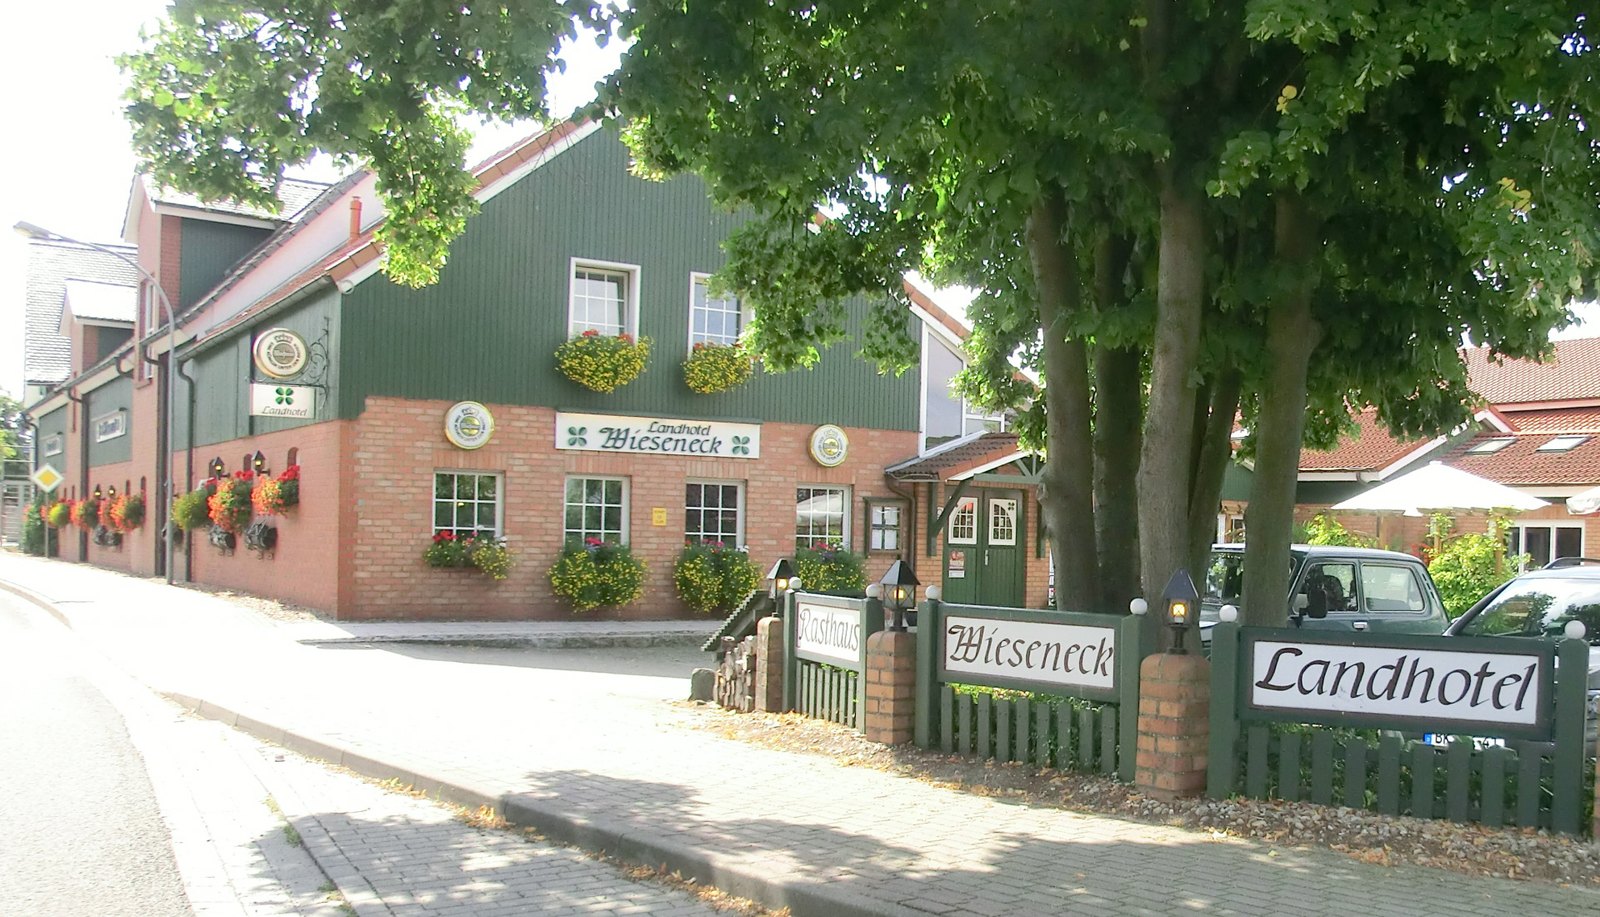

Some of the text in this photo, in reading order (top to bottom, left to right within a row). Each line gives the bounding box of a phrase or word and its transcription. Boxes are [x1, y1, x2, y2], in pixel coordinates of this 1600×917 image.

[262, 406, 308, 416] Landhotel
[599, 427, 722, 454] Wieseneck
[647, 422, 711, 436] Landhotel
[799, 608, 860, 651] Rasthaus
[948, 624, 1114, 677] Wieseneck
[1255, 647, 1537, 711] Landhotel
